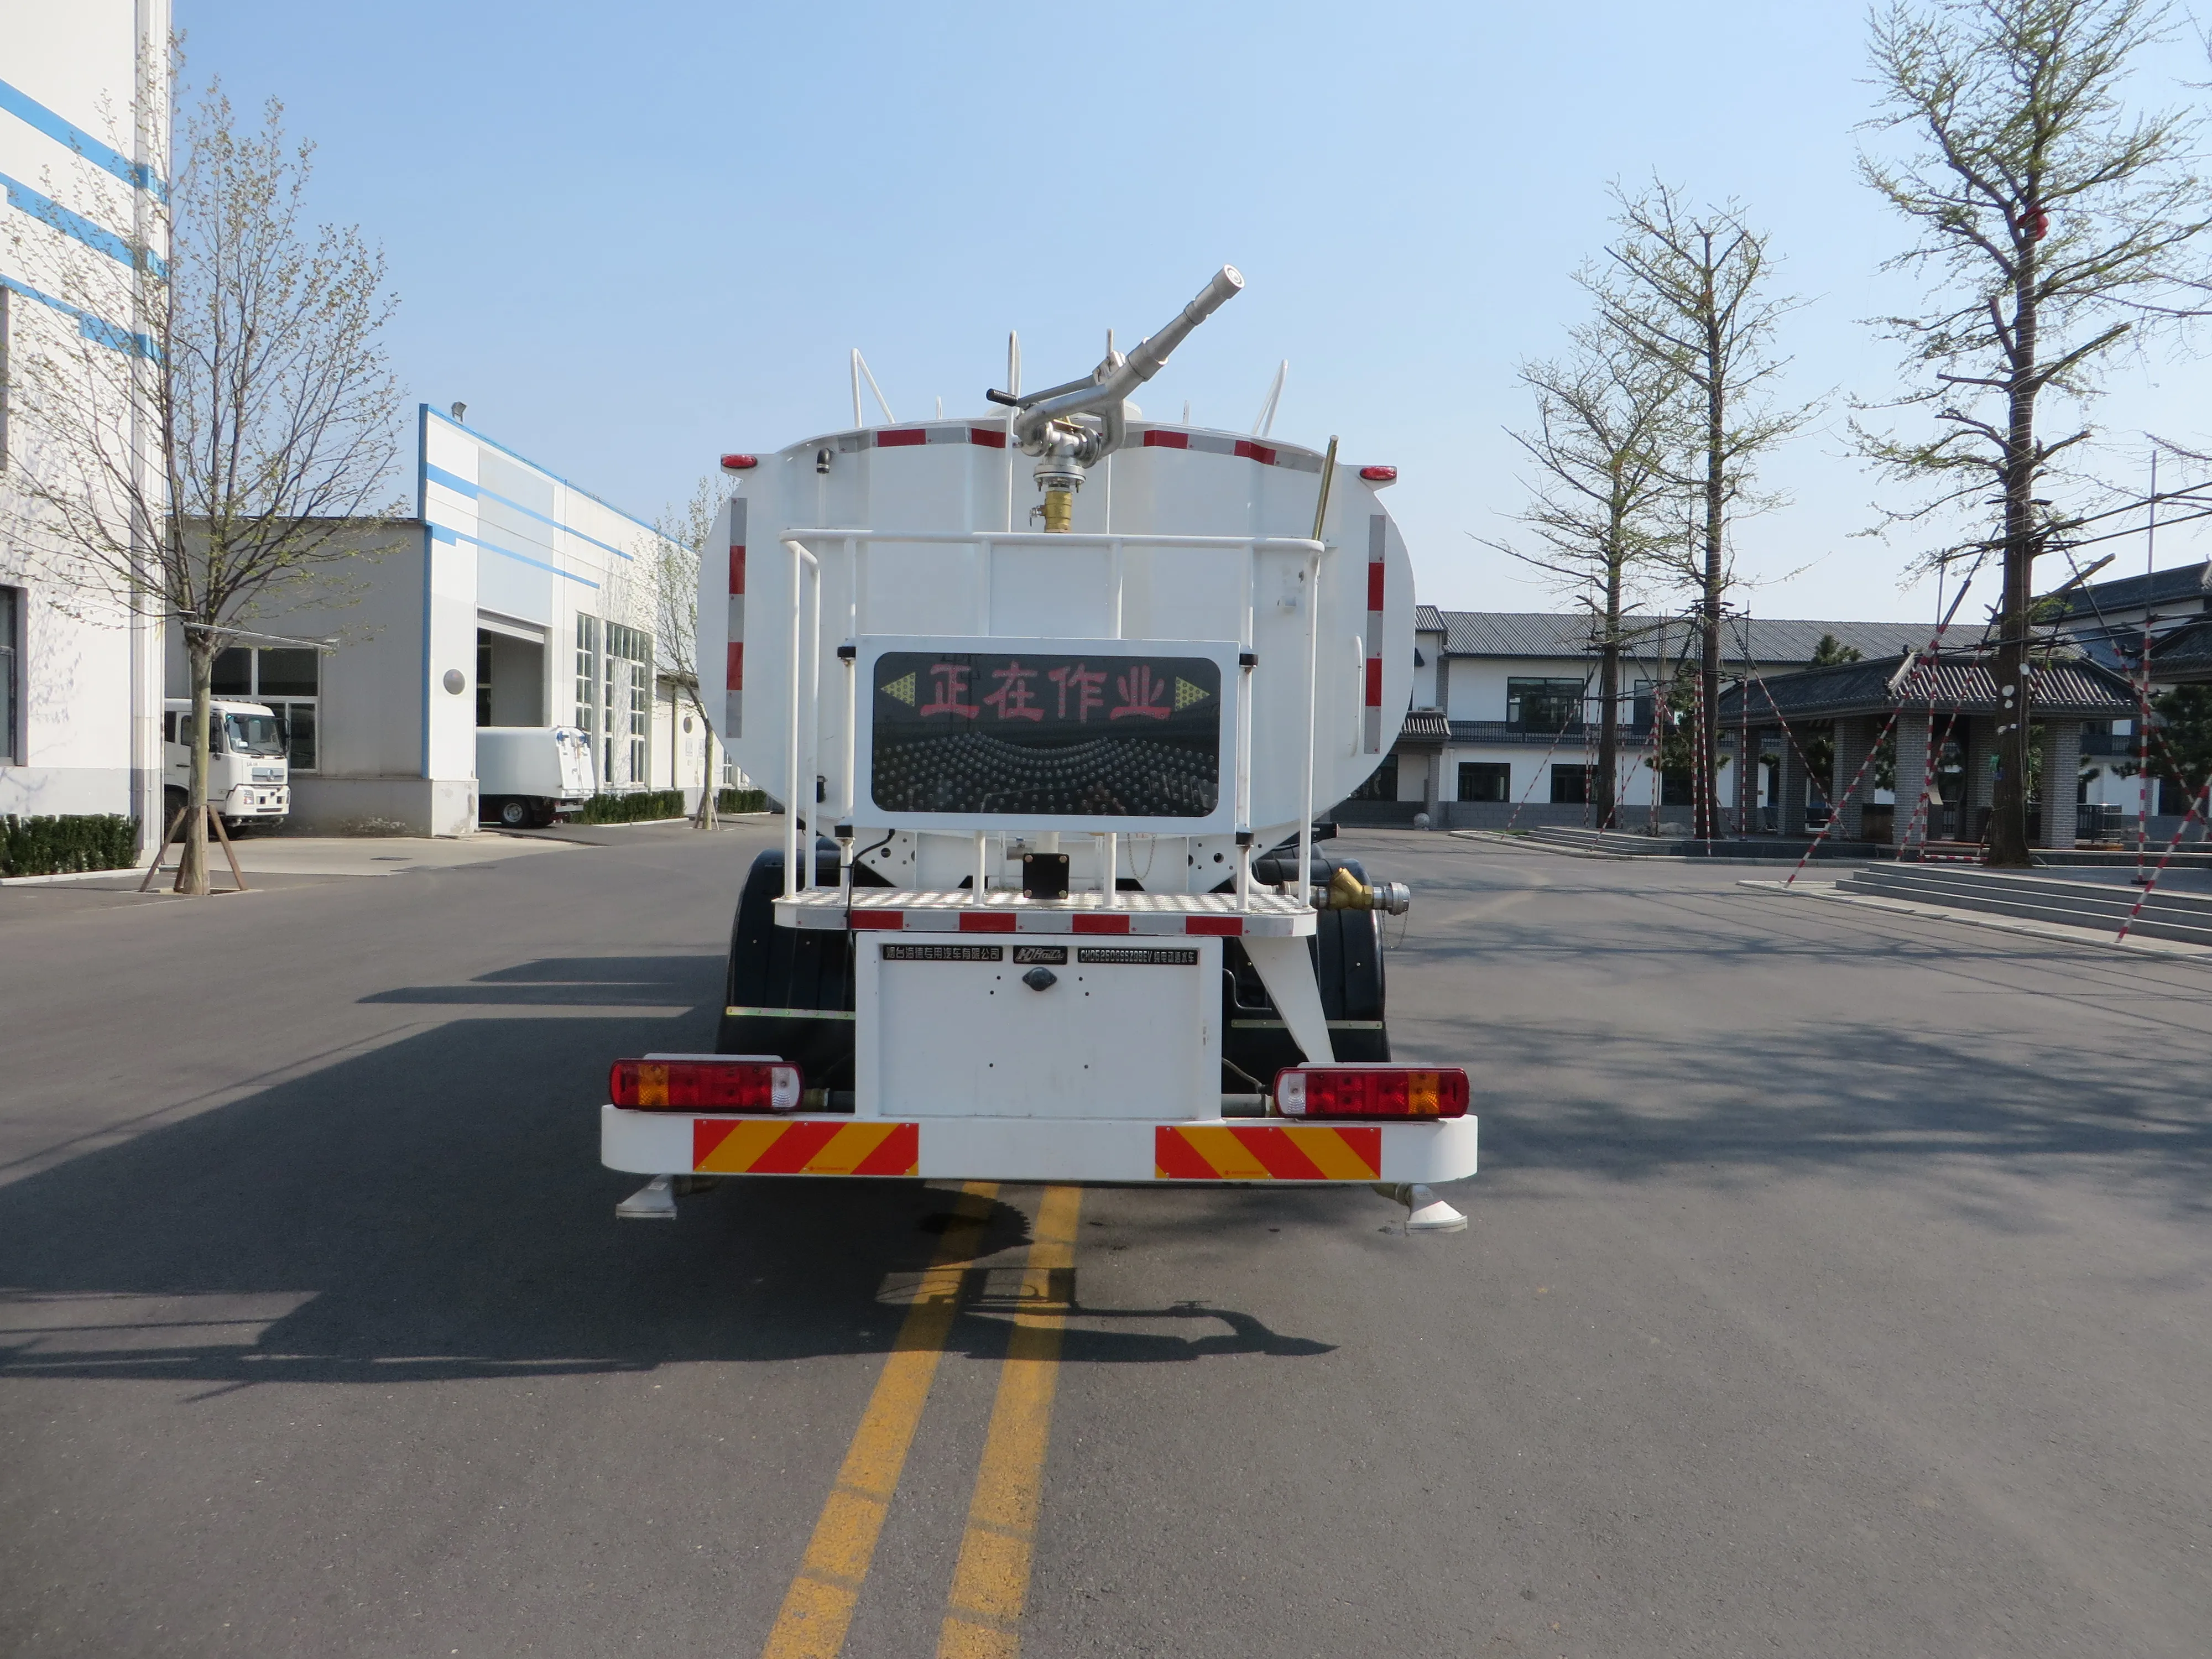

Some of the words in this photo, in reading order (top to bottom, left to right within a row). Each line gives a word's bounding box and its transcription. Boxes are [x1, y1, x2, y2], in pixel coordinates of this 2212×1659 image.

[920, 662, 1171, 723] 正在作业
[886, 947, 999, 959] 烟台海德专用汽车有限公司
